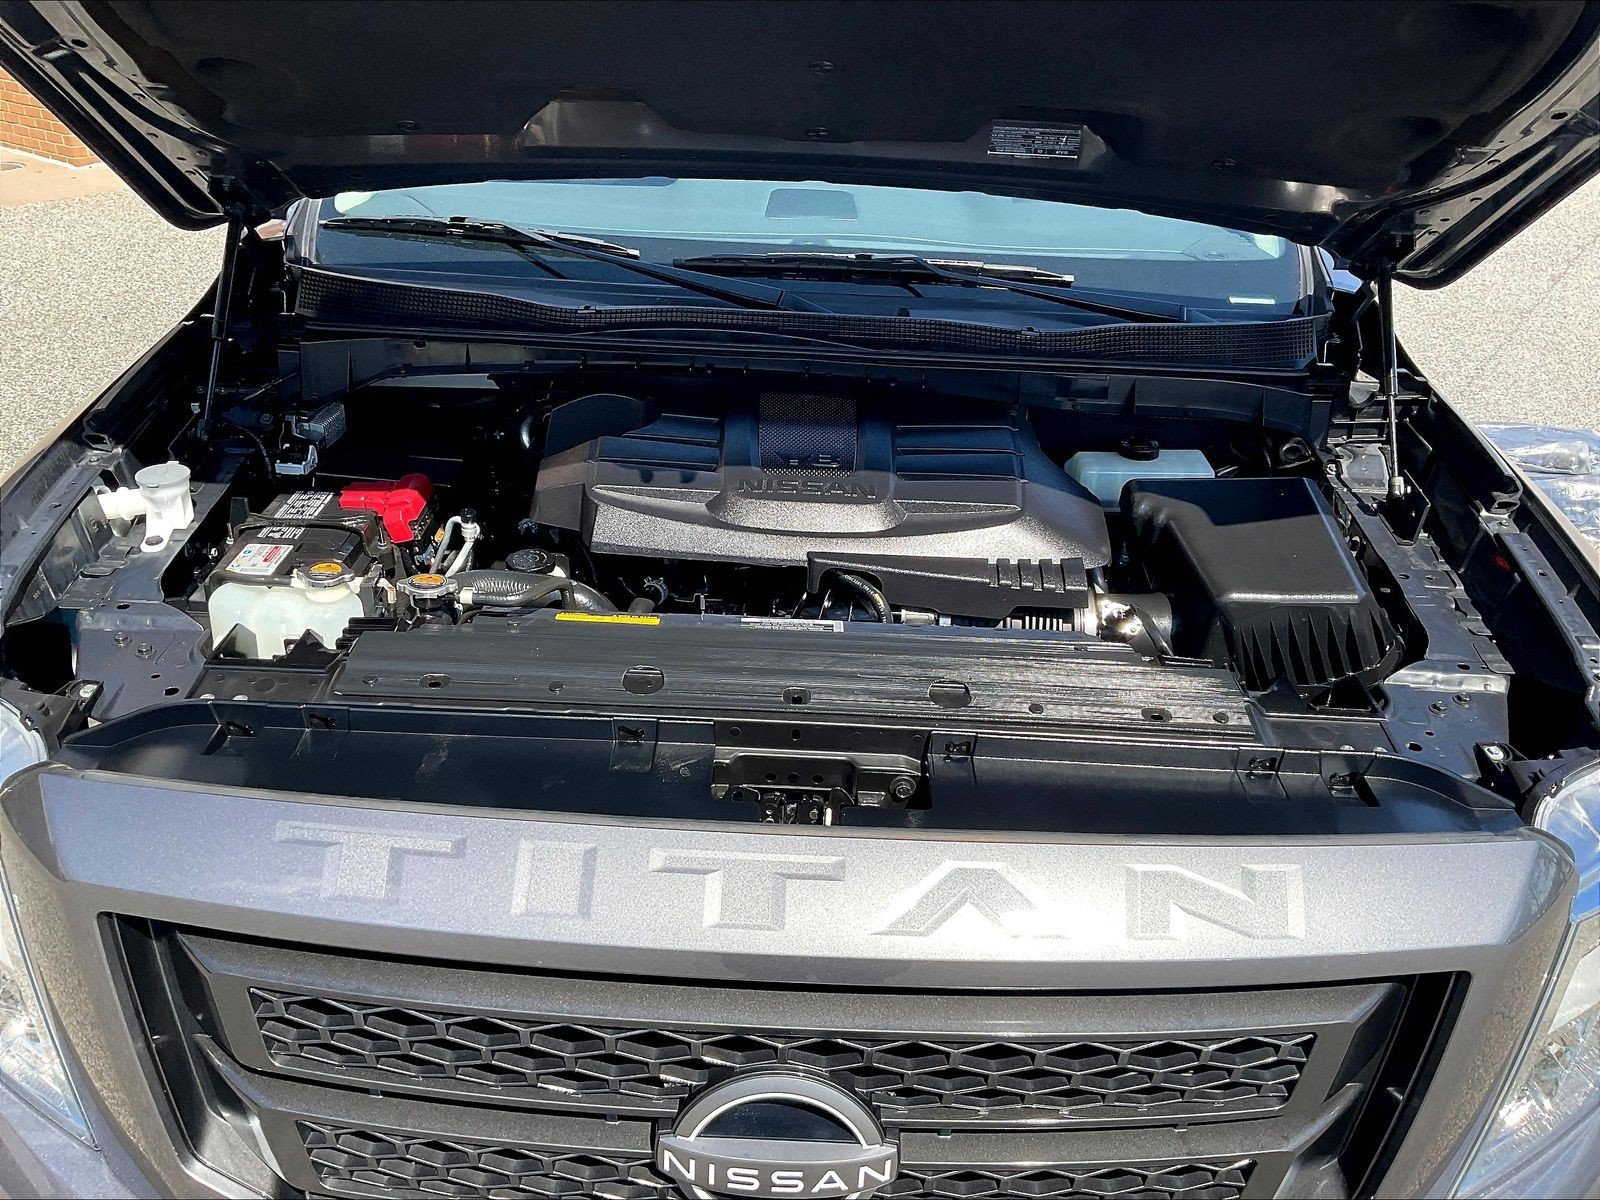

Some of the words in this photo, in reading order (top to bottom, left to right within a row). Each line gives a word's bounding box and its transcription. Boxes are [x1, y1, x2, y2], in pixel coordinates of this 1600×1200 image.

[738, 478, 877, 499] NISSAN
[273, 821, 1305, 941] TITAN
[663, 1149, 892, 1194] NISSAN
